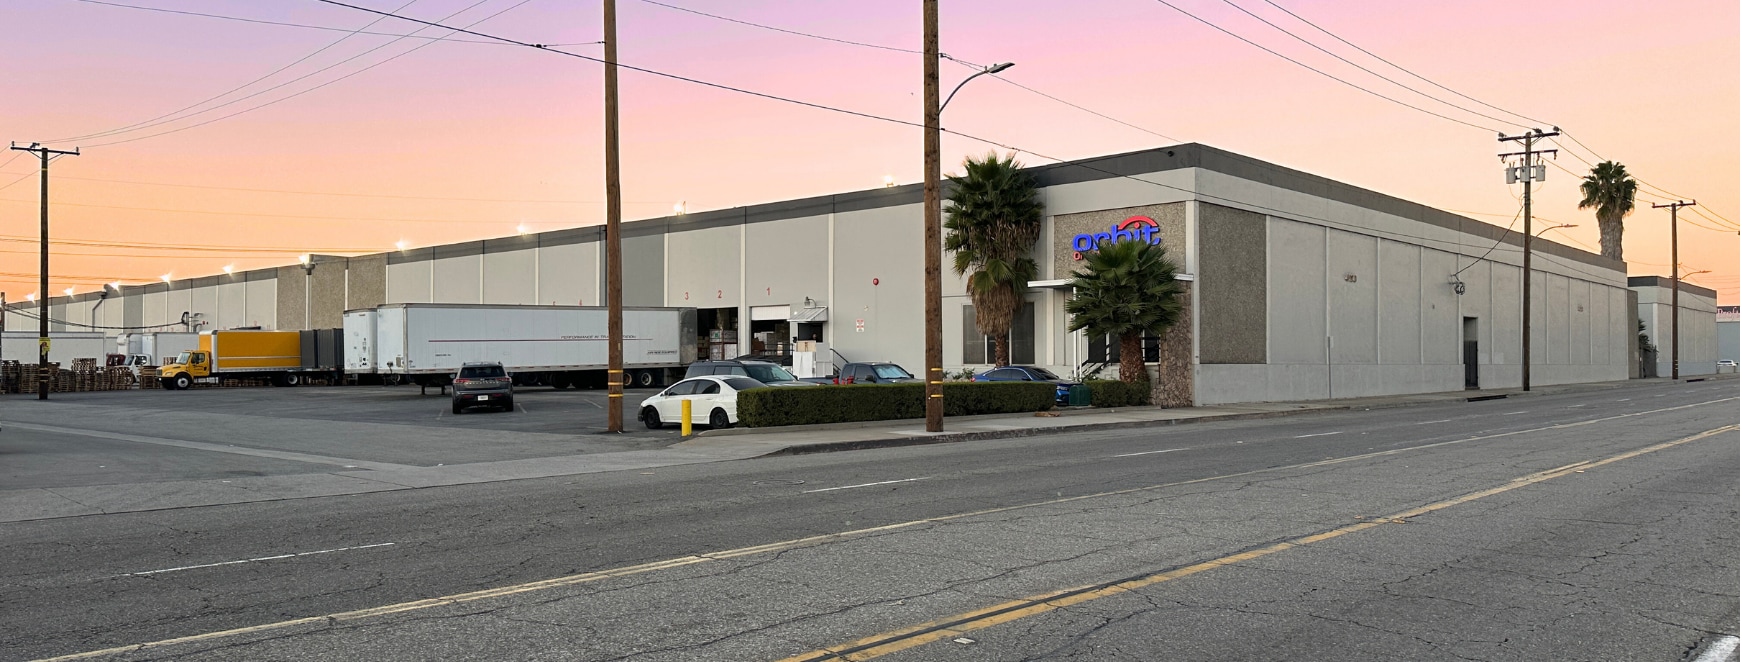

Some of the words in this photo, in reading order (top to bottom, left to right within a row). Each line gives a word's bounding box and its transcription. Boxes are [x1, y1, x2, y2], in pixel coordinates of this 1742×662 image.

[1072, 222, 1161, 252] orbit
[685, 292, 689, 300] 3
[718, 290, 722, 299] 2
[766, 287, 770, 296] 1
